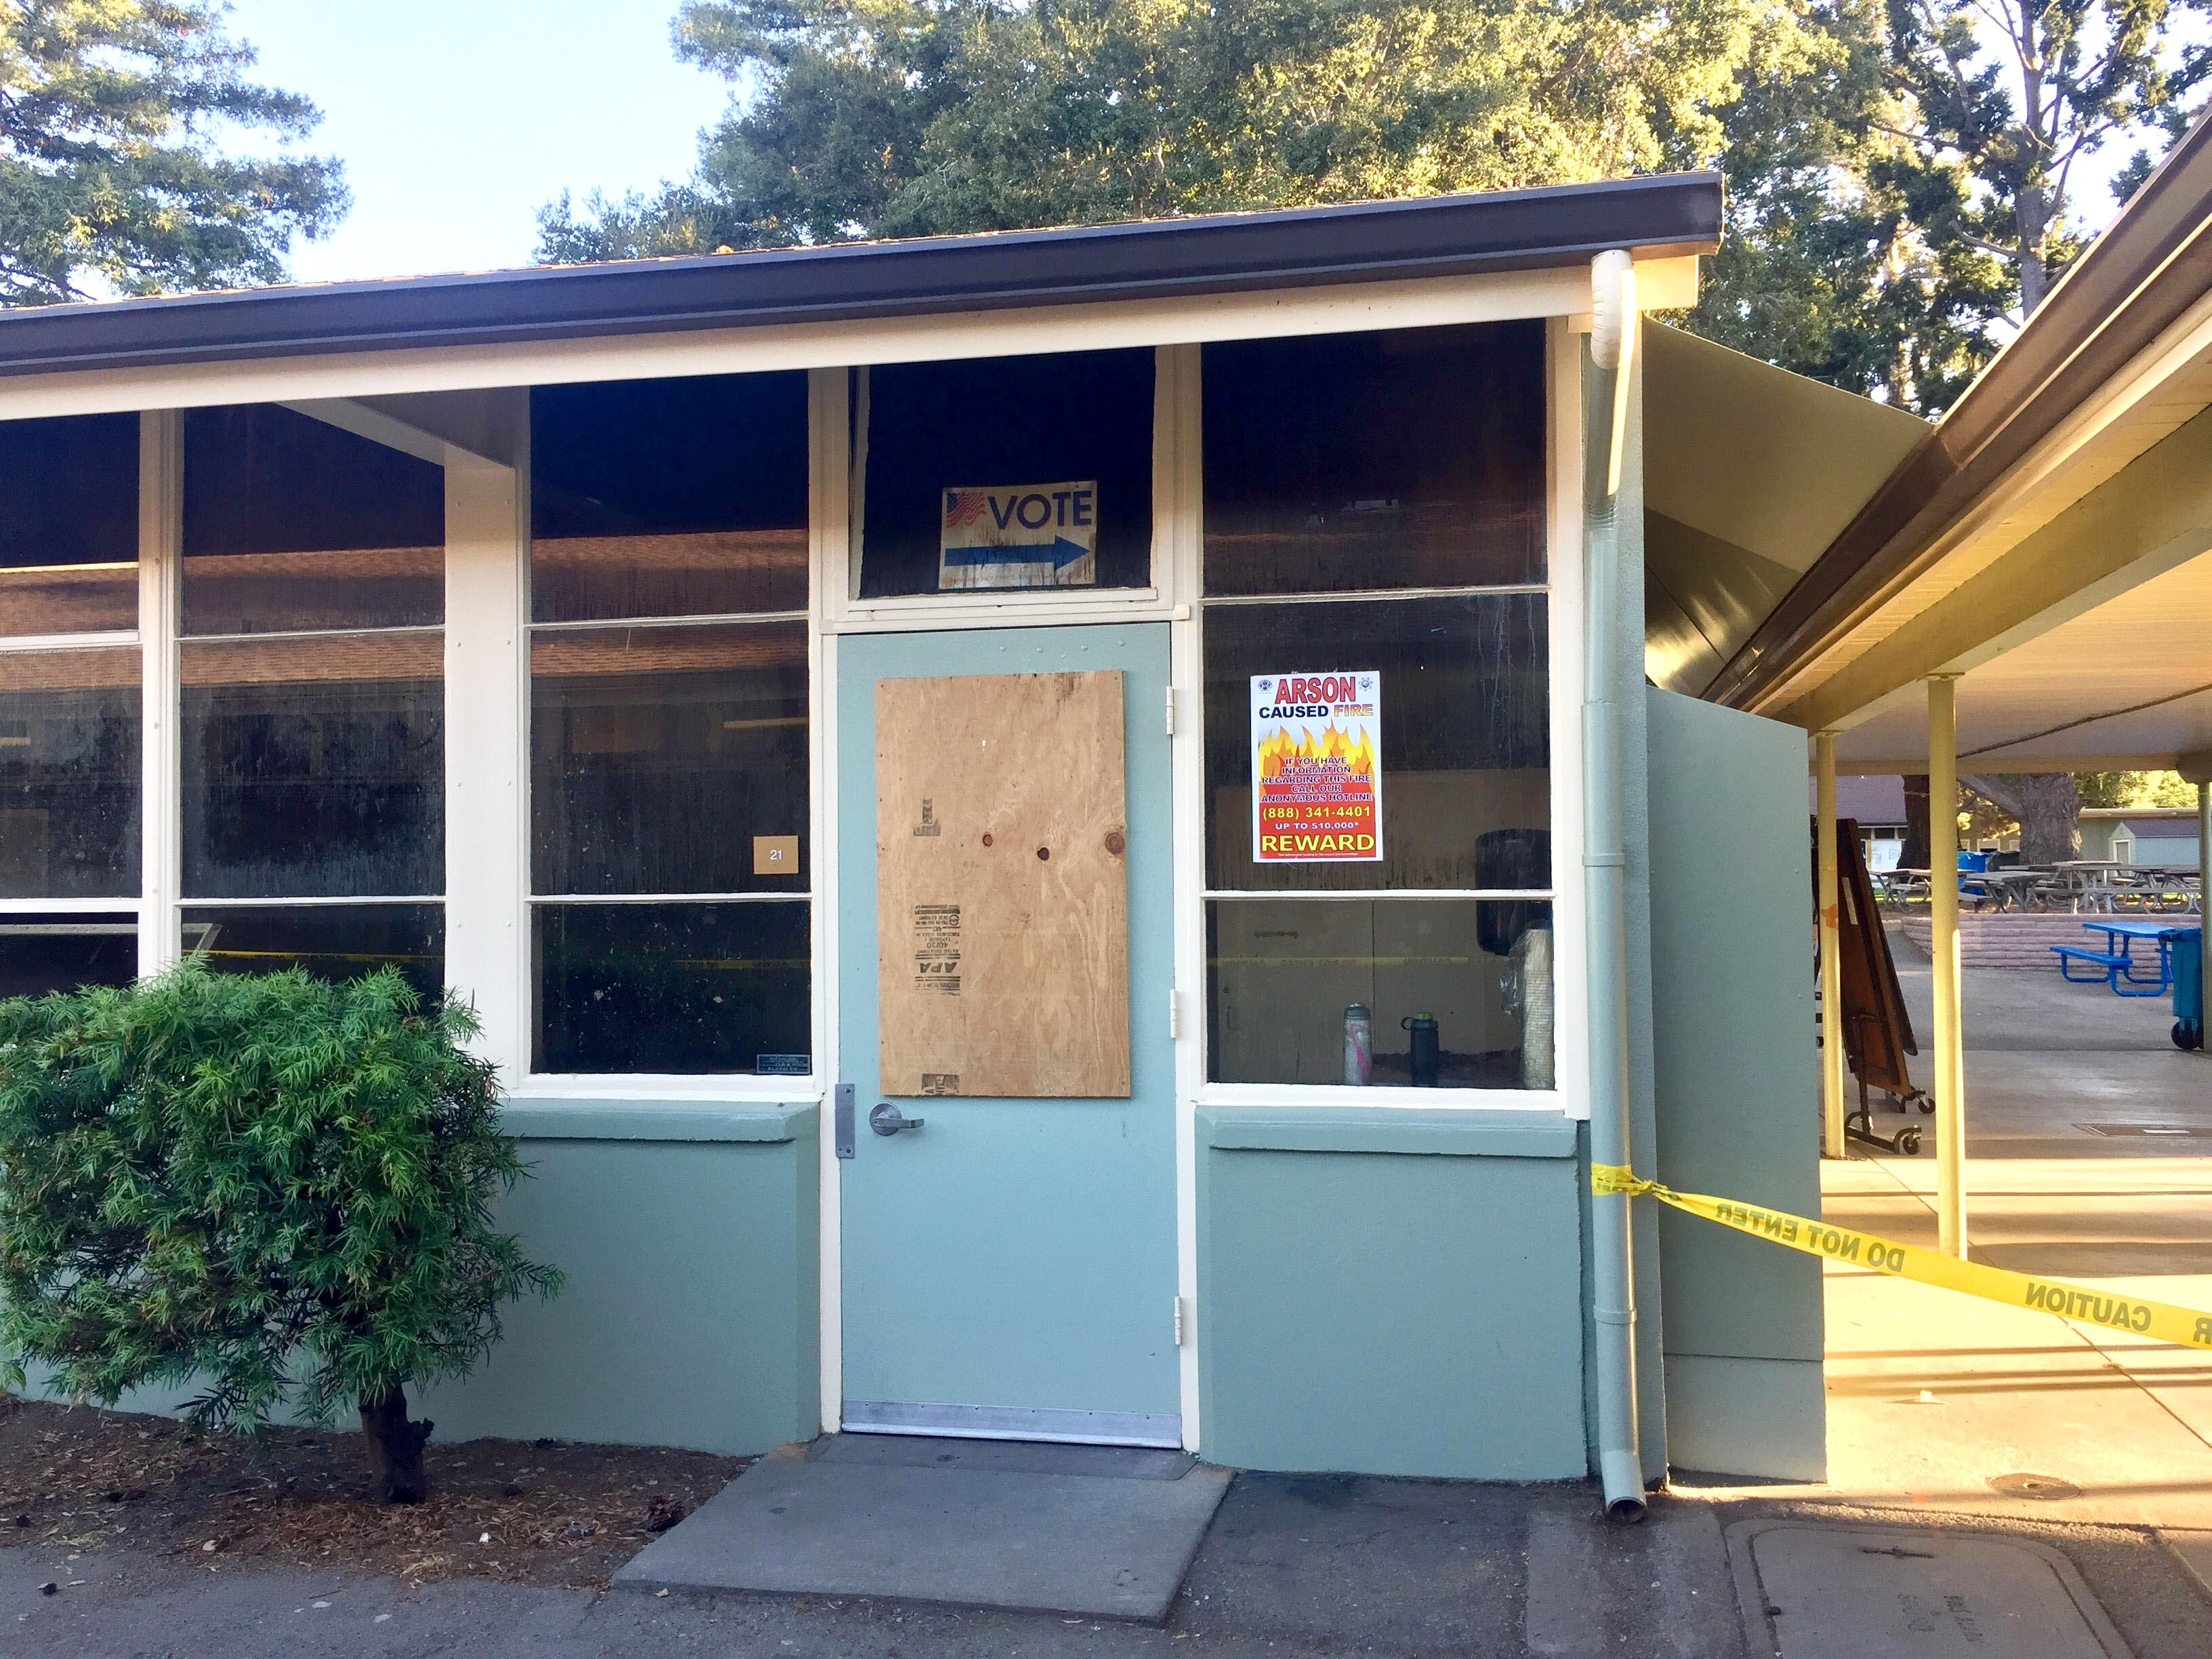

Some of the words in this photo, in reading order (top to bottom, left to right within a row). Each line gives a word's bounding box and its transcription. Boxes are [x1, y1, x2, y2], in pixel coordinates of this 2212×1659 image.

[988, 491, 1092, 530] VOTE
[1275, 676, 1355, 704] ARSON
[1259, 705, 1328, 718] CAUSED
[1334, 704, 1373, 717] FIRE
[1329, 793, 1372, 801] HOTLINE
[1263, 808, 1299, 821] (888)
[1305, 806, 1370, 818] 341-4401
[1261, 834, 1375, 852] REWARD
[770, 849, 783, 860] 21
[920, 962, 957, 973] APA
